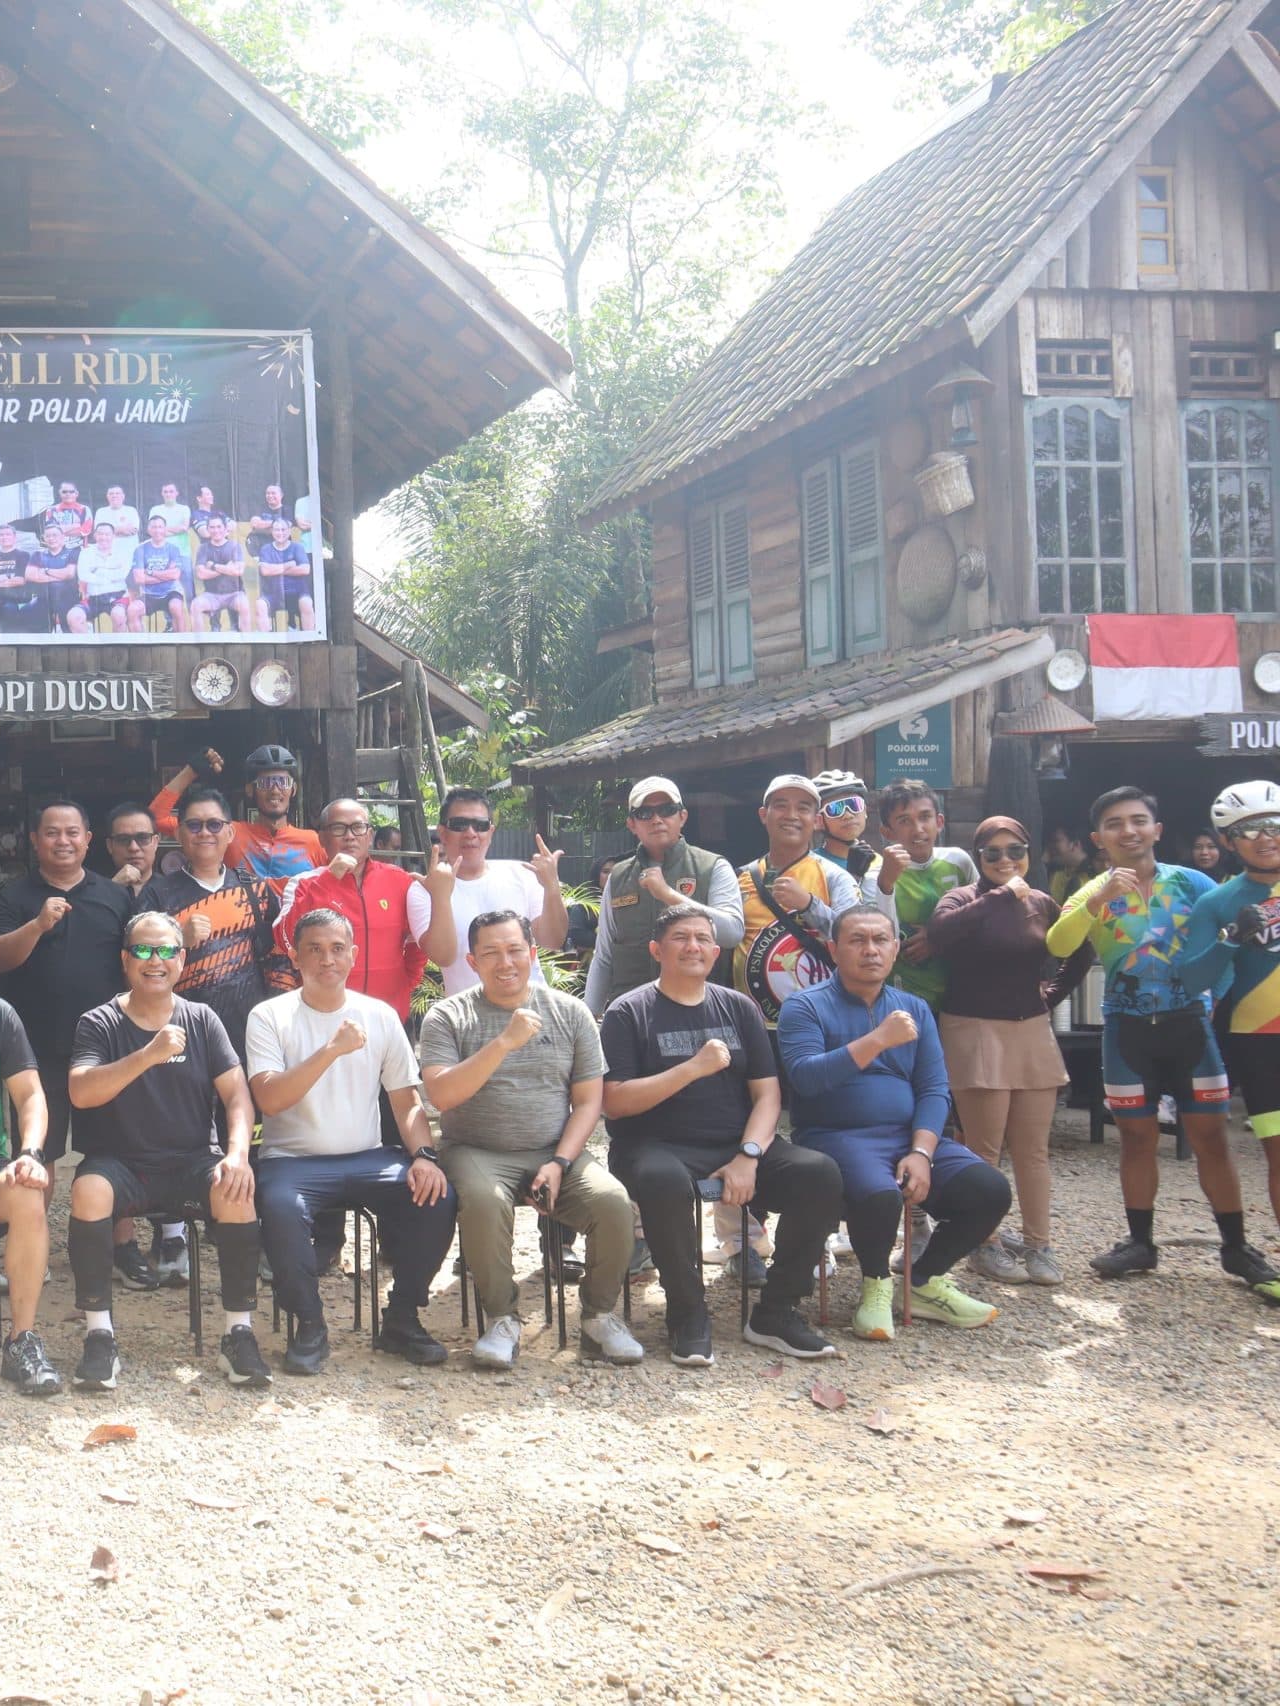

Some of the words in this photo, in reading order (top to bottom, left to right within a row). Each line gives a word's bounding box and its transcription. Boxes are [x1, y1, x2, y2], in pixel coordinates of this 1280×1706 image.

[72, 352, 175, 386] RIDE
[28, 397, 108, 424] POLDA
[114, 397, 192, 424] JAMBI
[44, 680, 155, 712] DUSUN
[887, 744, 917, 753] POJOK
[917, 743, 940, 753] KOPI
[898, 758, 929, 766] DUSUN
